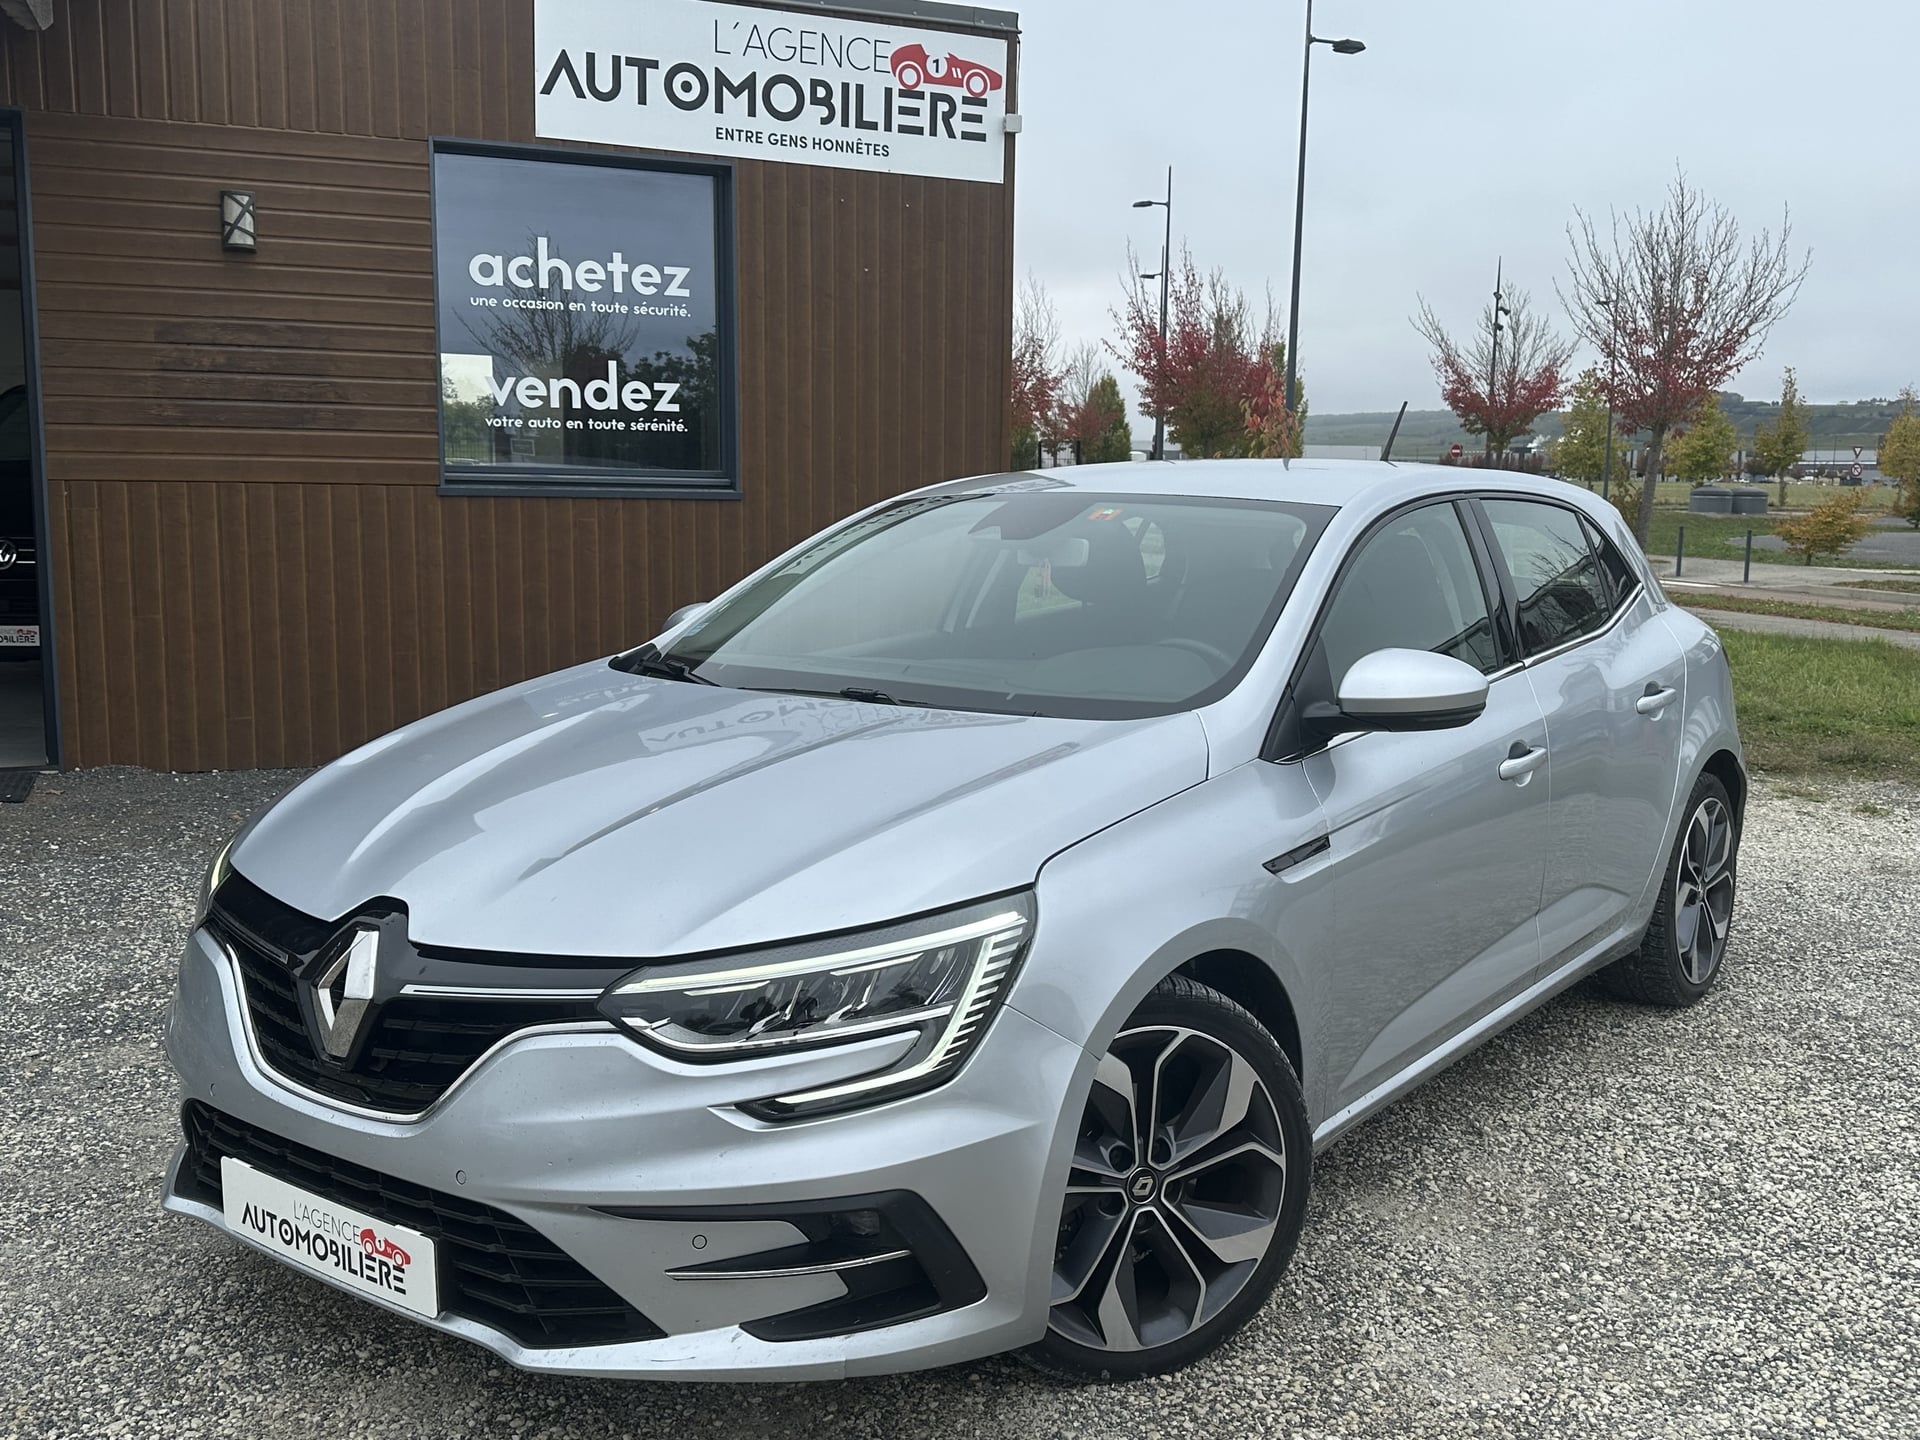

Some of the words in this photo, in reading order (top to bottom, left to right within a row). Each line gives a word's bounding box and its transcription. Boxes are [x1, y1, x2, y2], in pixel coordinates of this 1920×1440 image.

[714, 19, 891, 73] L'AGENCE
[539, 49, 988, 142] AUTOMOBILIERE
[715, 126, 764, 145] ENTRE
[767, 132, 808, 149] GENS
[812, 134, 890, 158] HONNÊTES
[469, 236, 691, 298] achetez
[470, 296, 498, 308] une
[502, 296, 564, 311] occasion
[568, 302, 587, 313] en
[590, 300, 629, 314] toute
[633, 301, 691, 318] sécurité.
[485, 360, 681, 412] vendez
[485, 416, 523, 428] votre
[527, 417, 562, 430] auto
[566, 420, 584, 431] en
[587, 418, 626, 432] toute
[630, 417, 688, 433] sérénité.
[242, 1201, 407, 1296] AUTOMOBILIERE
